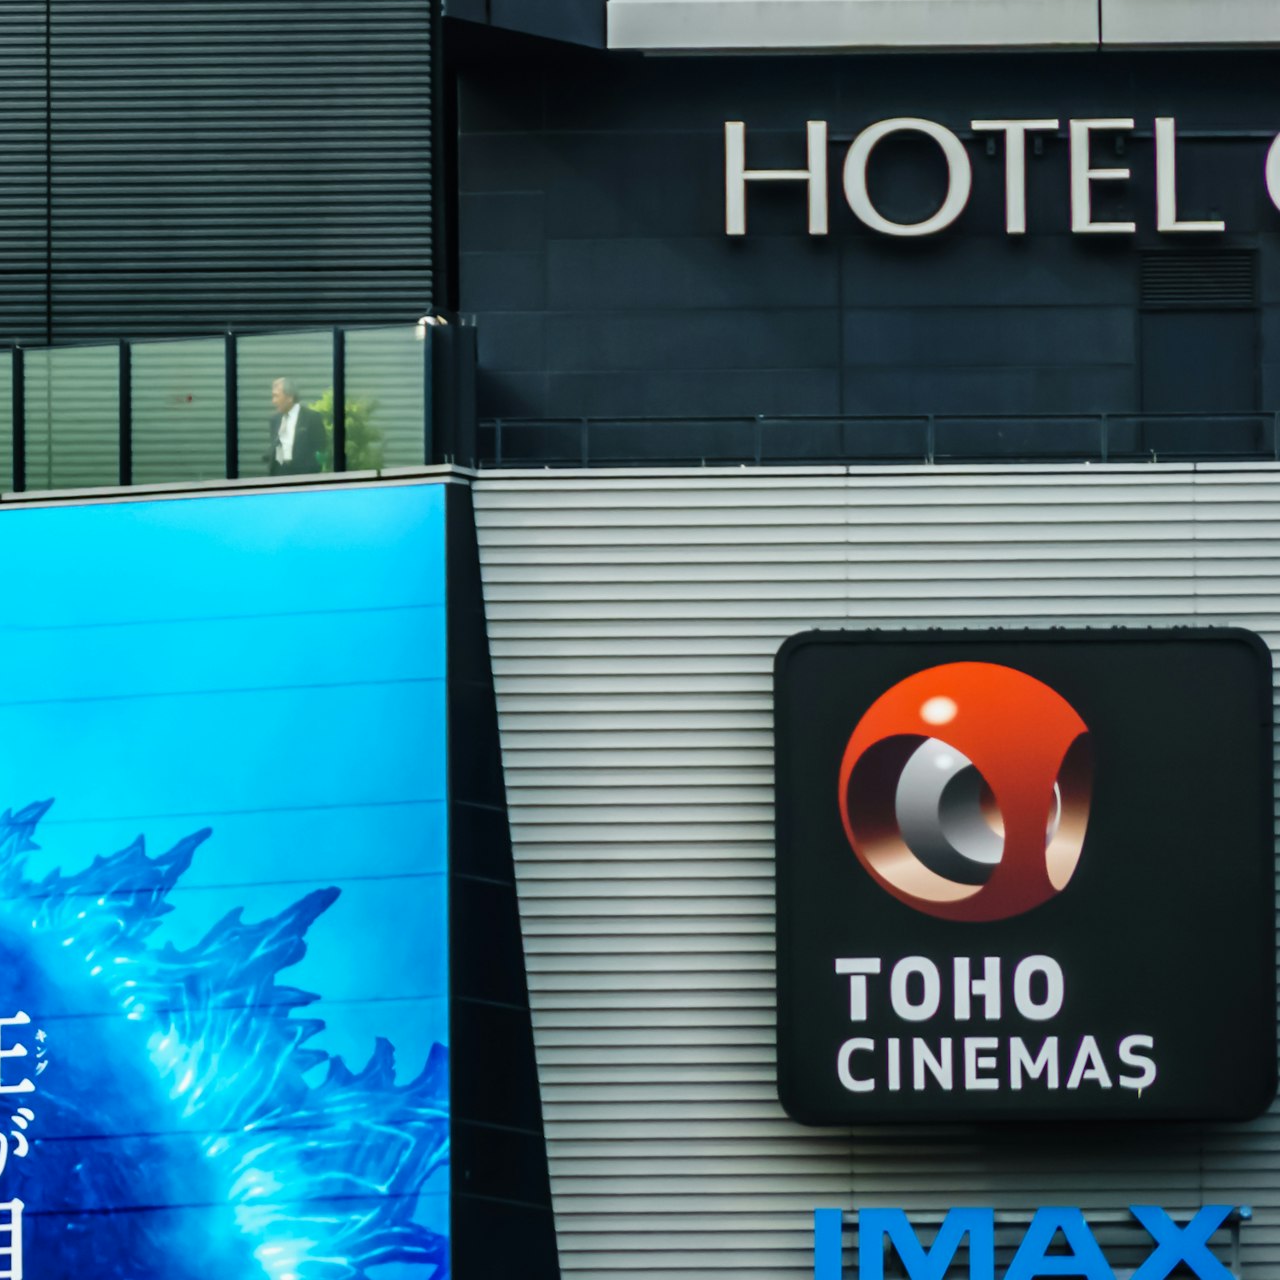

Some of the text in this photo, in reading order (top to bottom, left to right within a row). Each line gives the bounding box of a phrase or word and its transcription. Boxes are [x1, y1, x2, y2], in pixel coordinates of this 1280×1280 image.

[724, 117, 1226, 237] HOTEL
[835, 954, 1065, 1022] TOHO
[836, 1034, 1158, 1094] CINEMAS
[813, 1204, 1238, 1280] IMAX
